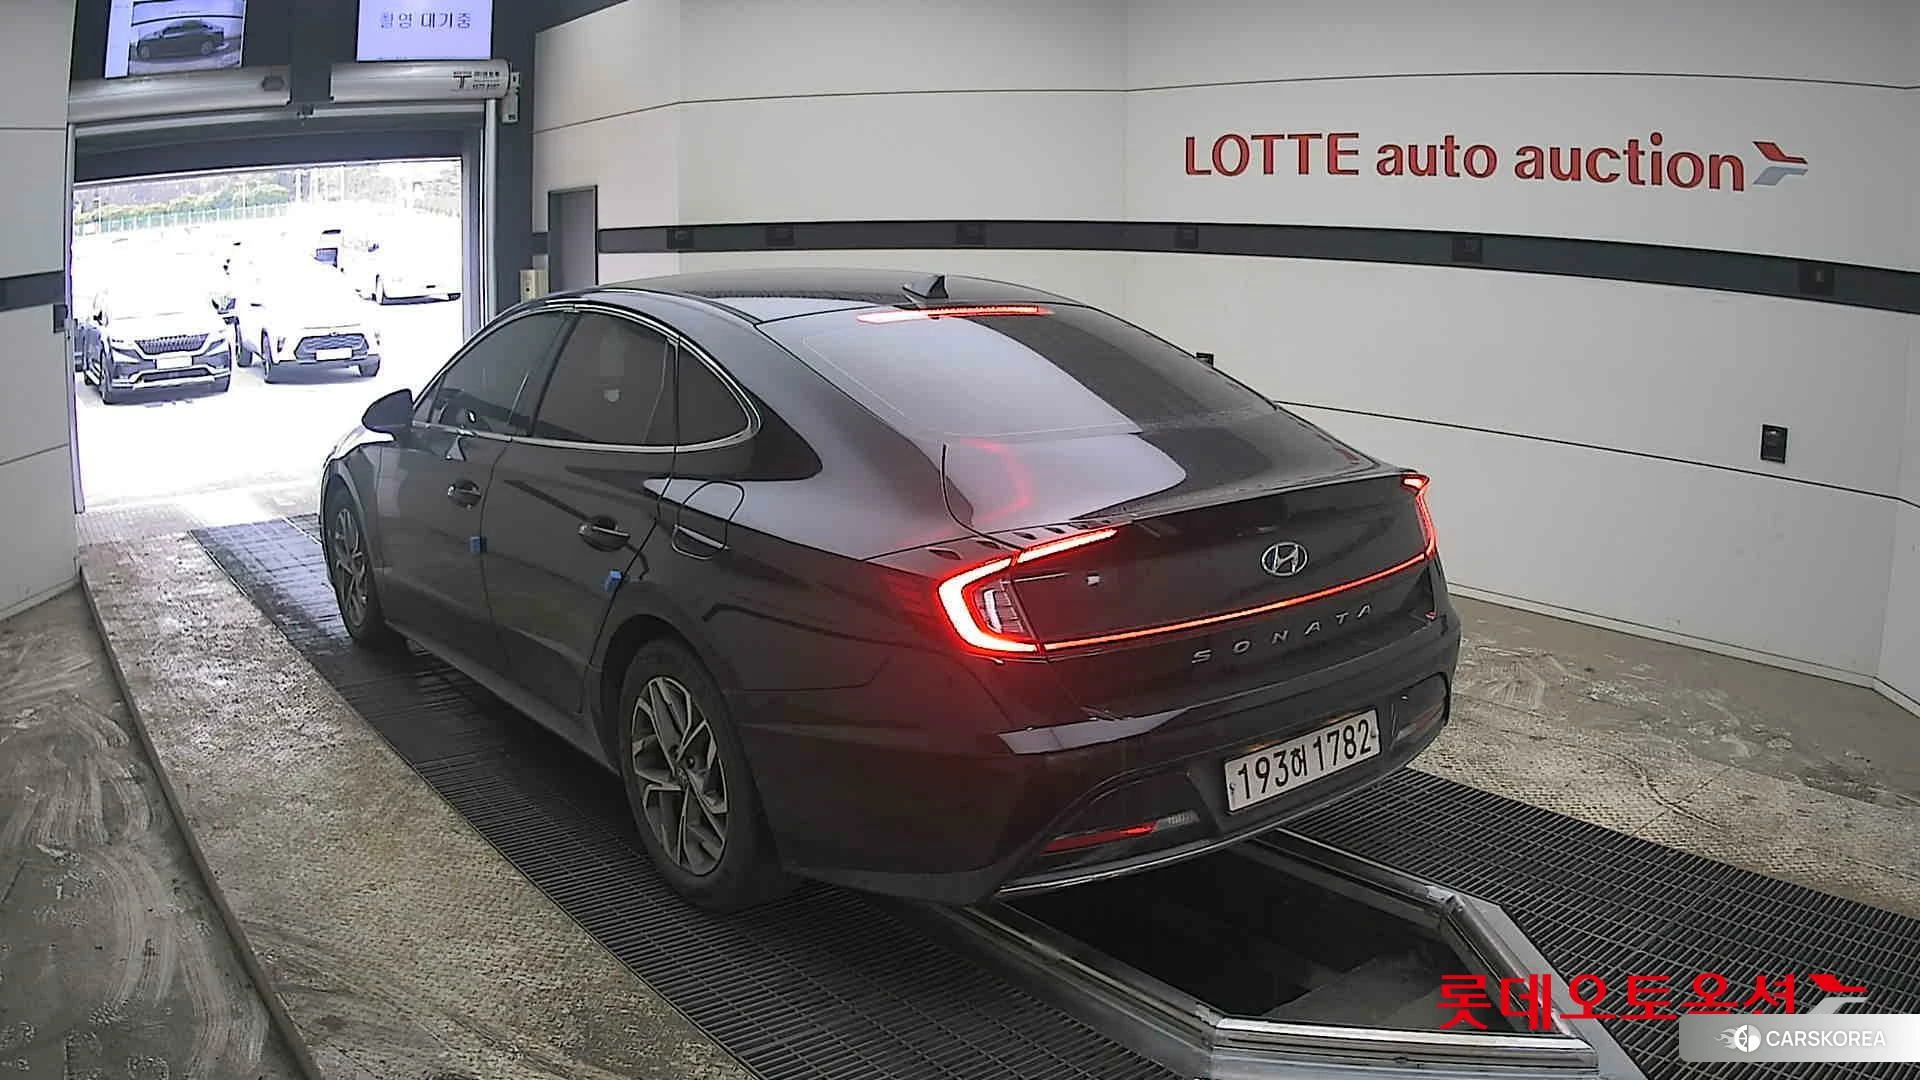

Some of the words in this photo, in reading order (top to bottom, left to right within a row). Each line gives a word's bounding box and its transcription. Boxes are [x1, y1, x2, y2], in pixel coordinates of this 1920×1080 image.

[1185, 132, 1360, 177] LOTTE
[1376, 134, 1498, 179] auto
[1513, 131, 1745, 192] auction
[1191, 603, 1373, 664] SONATA
